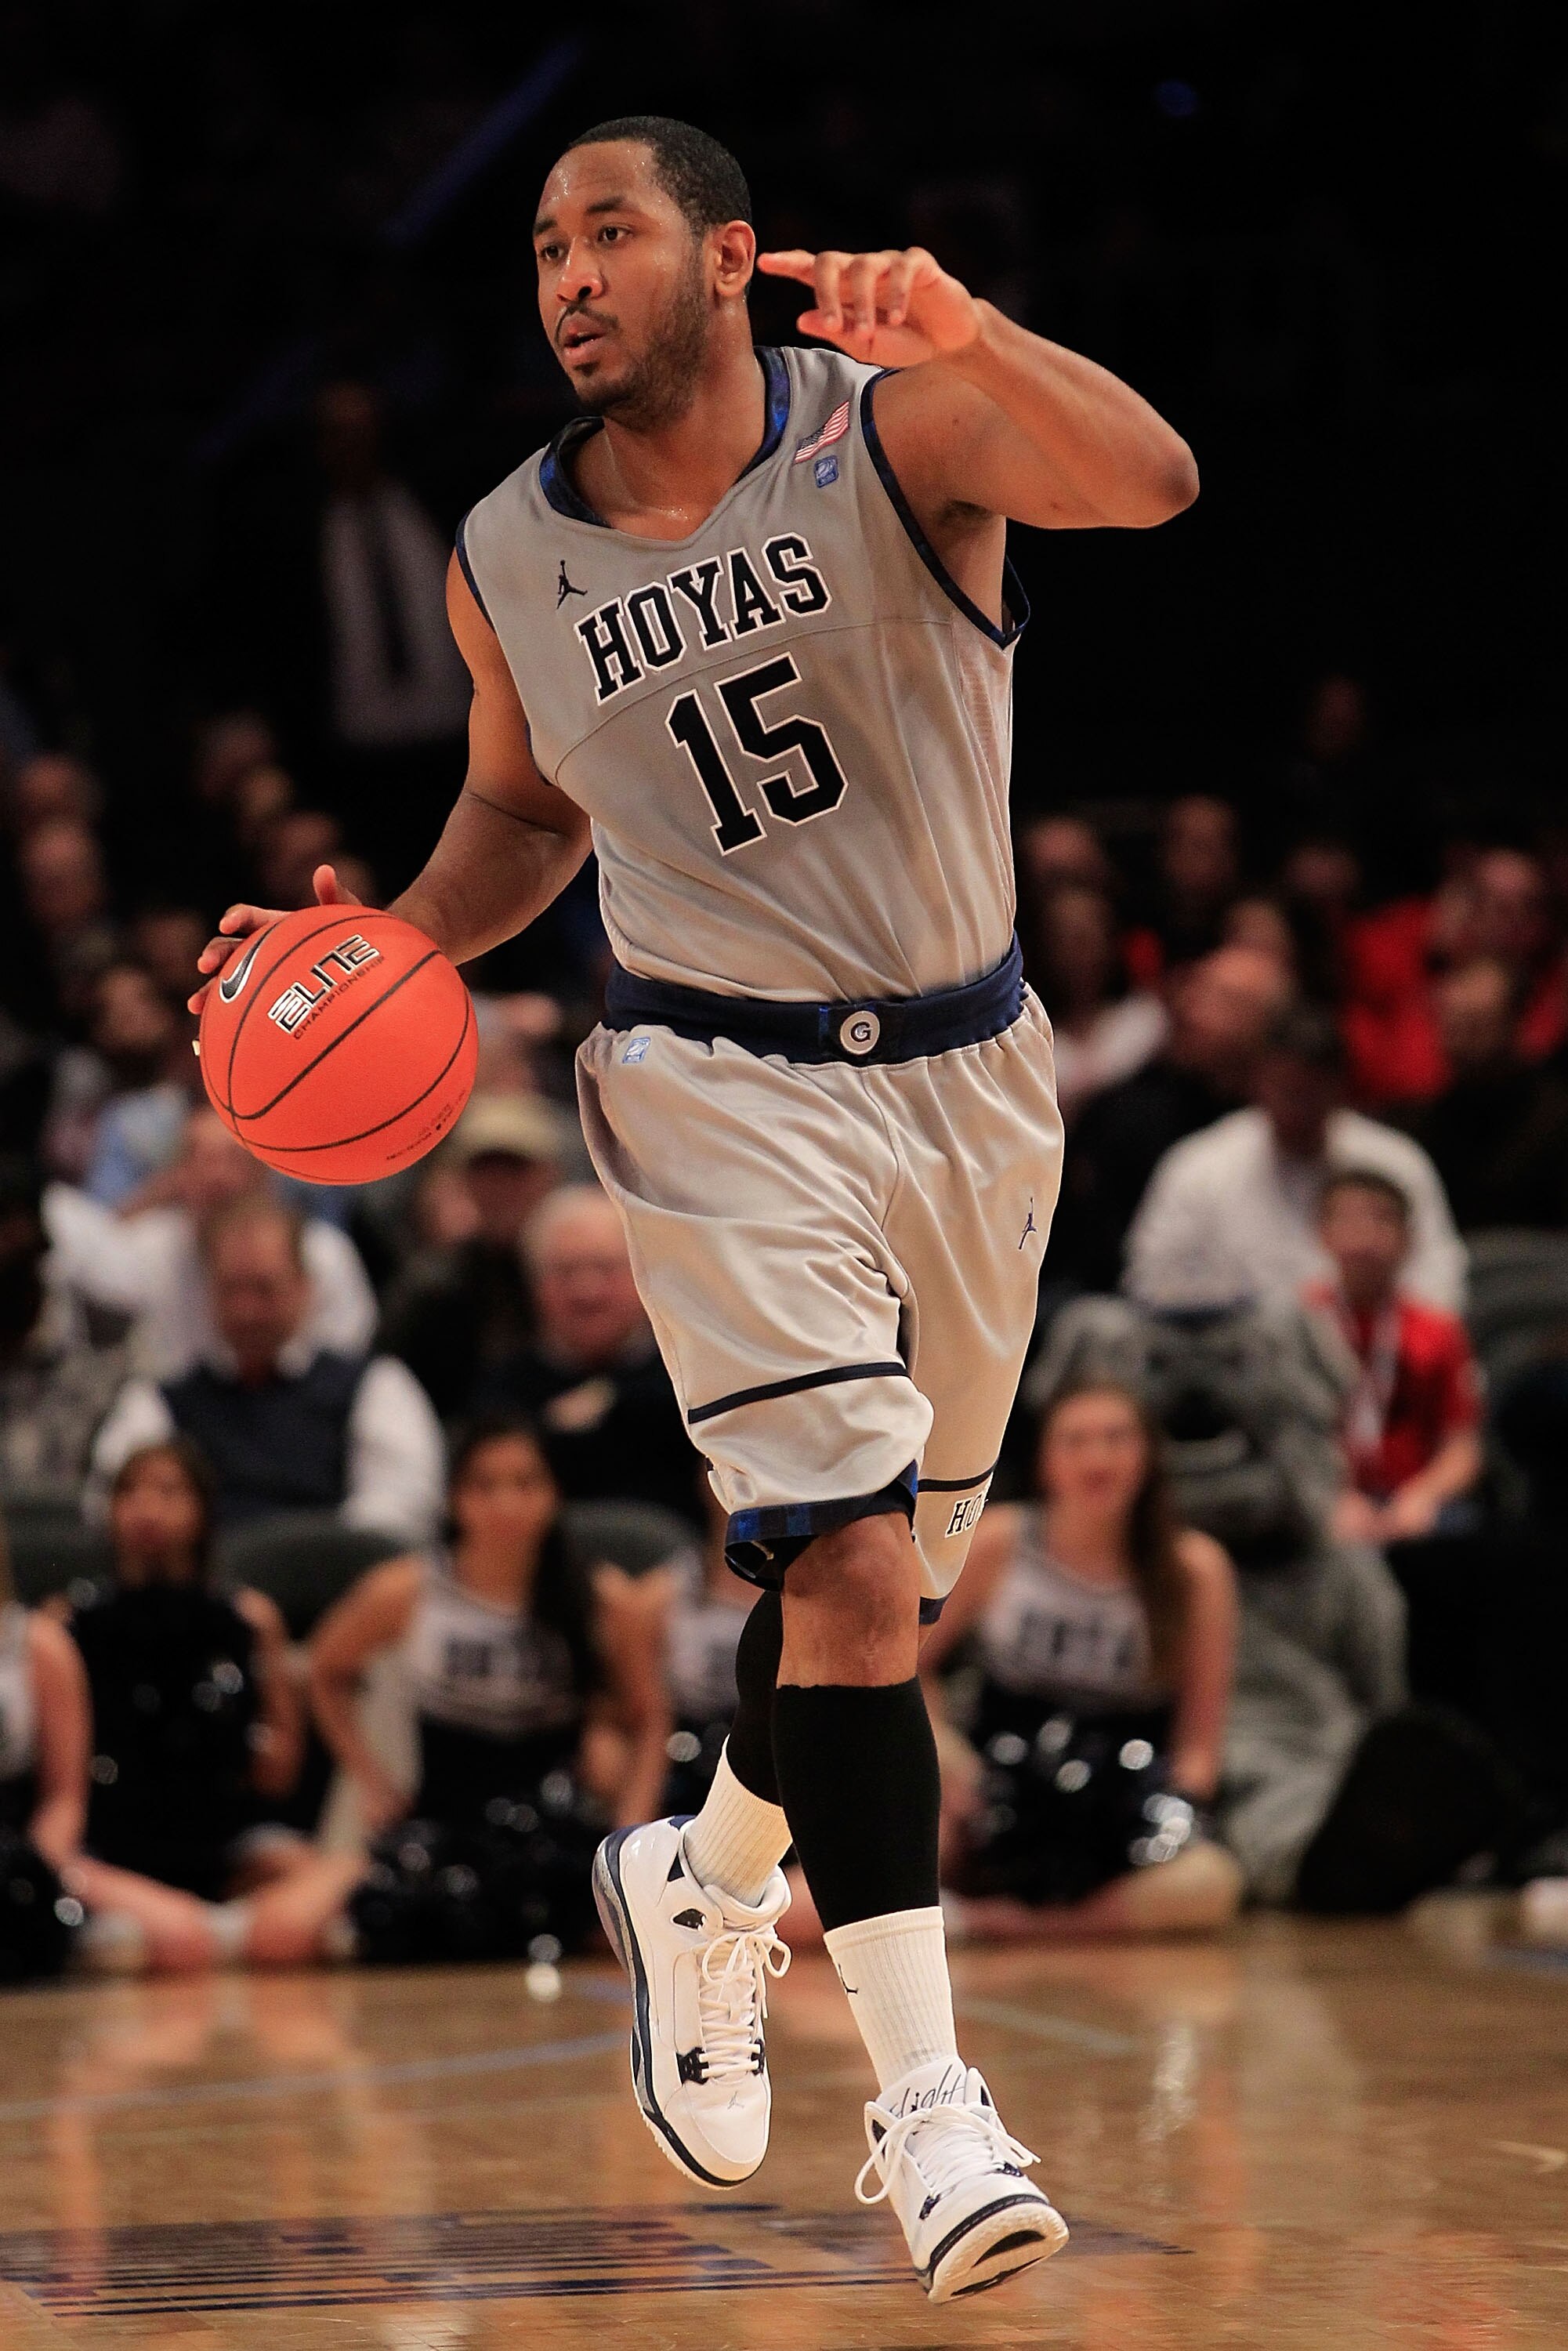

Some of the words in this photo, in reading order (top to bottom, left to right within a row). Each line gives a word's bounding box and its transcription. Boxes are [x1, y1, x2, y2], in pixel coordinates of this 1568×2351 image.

[574, 531, 832, 705] HOYAS
[665, 651, 849, 856] 15
[267, 933, 380, 1034] ELITE
[293, 955, 385, 1040] CHAMPIONSHIP
[849, 1020, 872, 1043] G
[944, 1491, 987, 1538] HO
